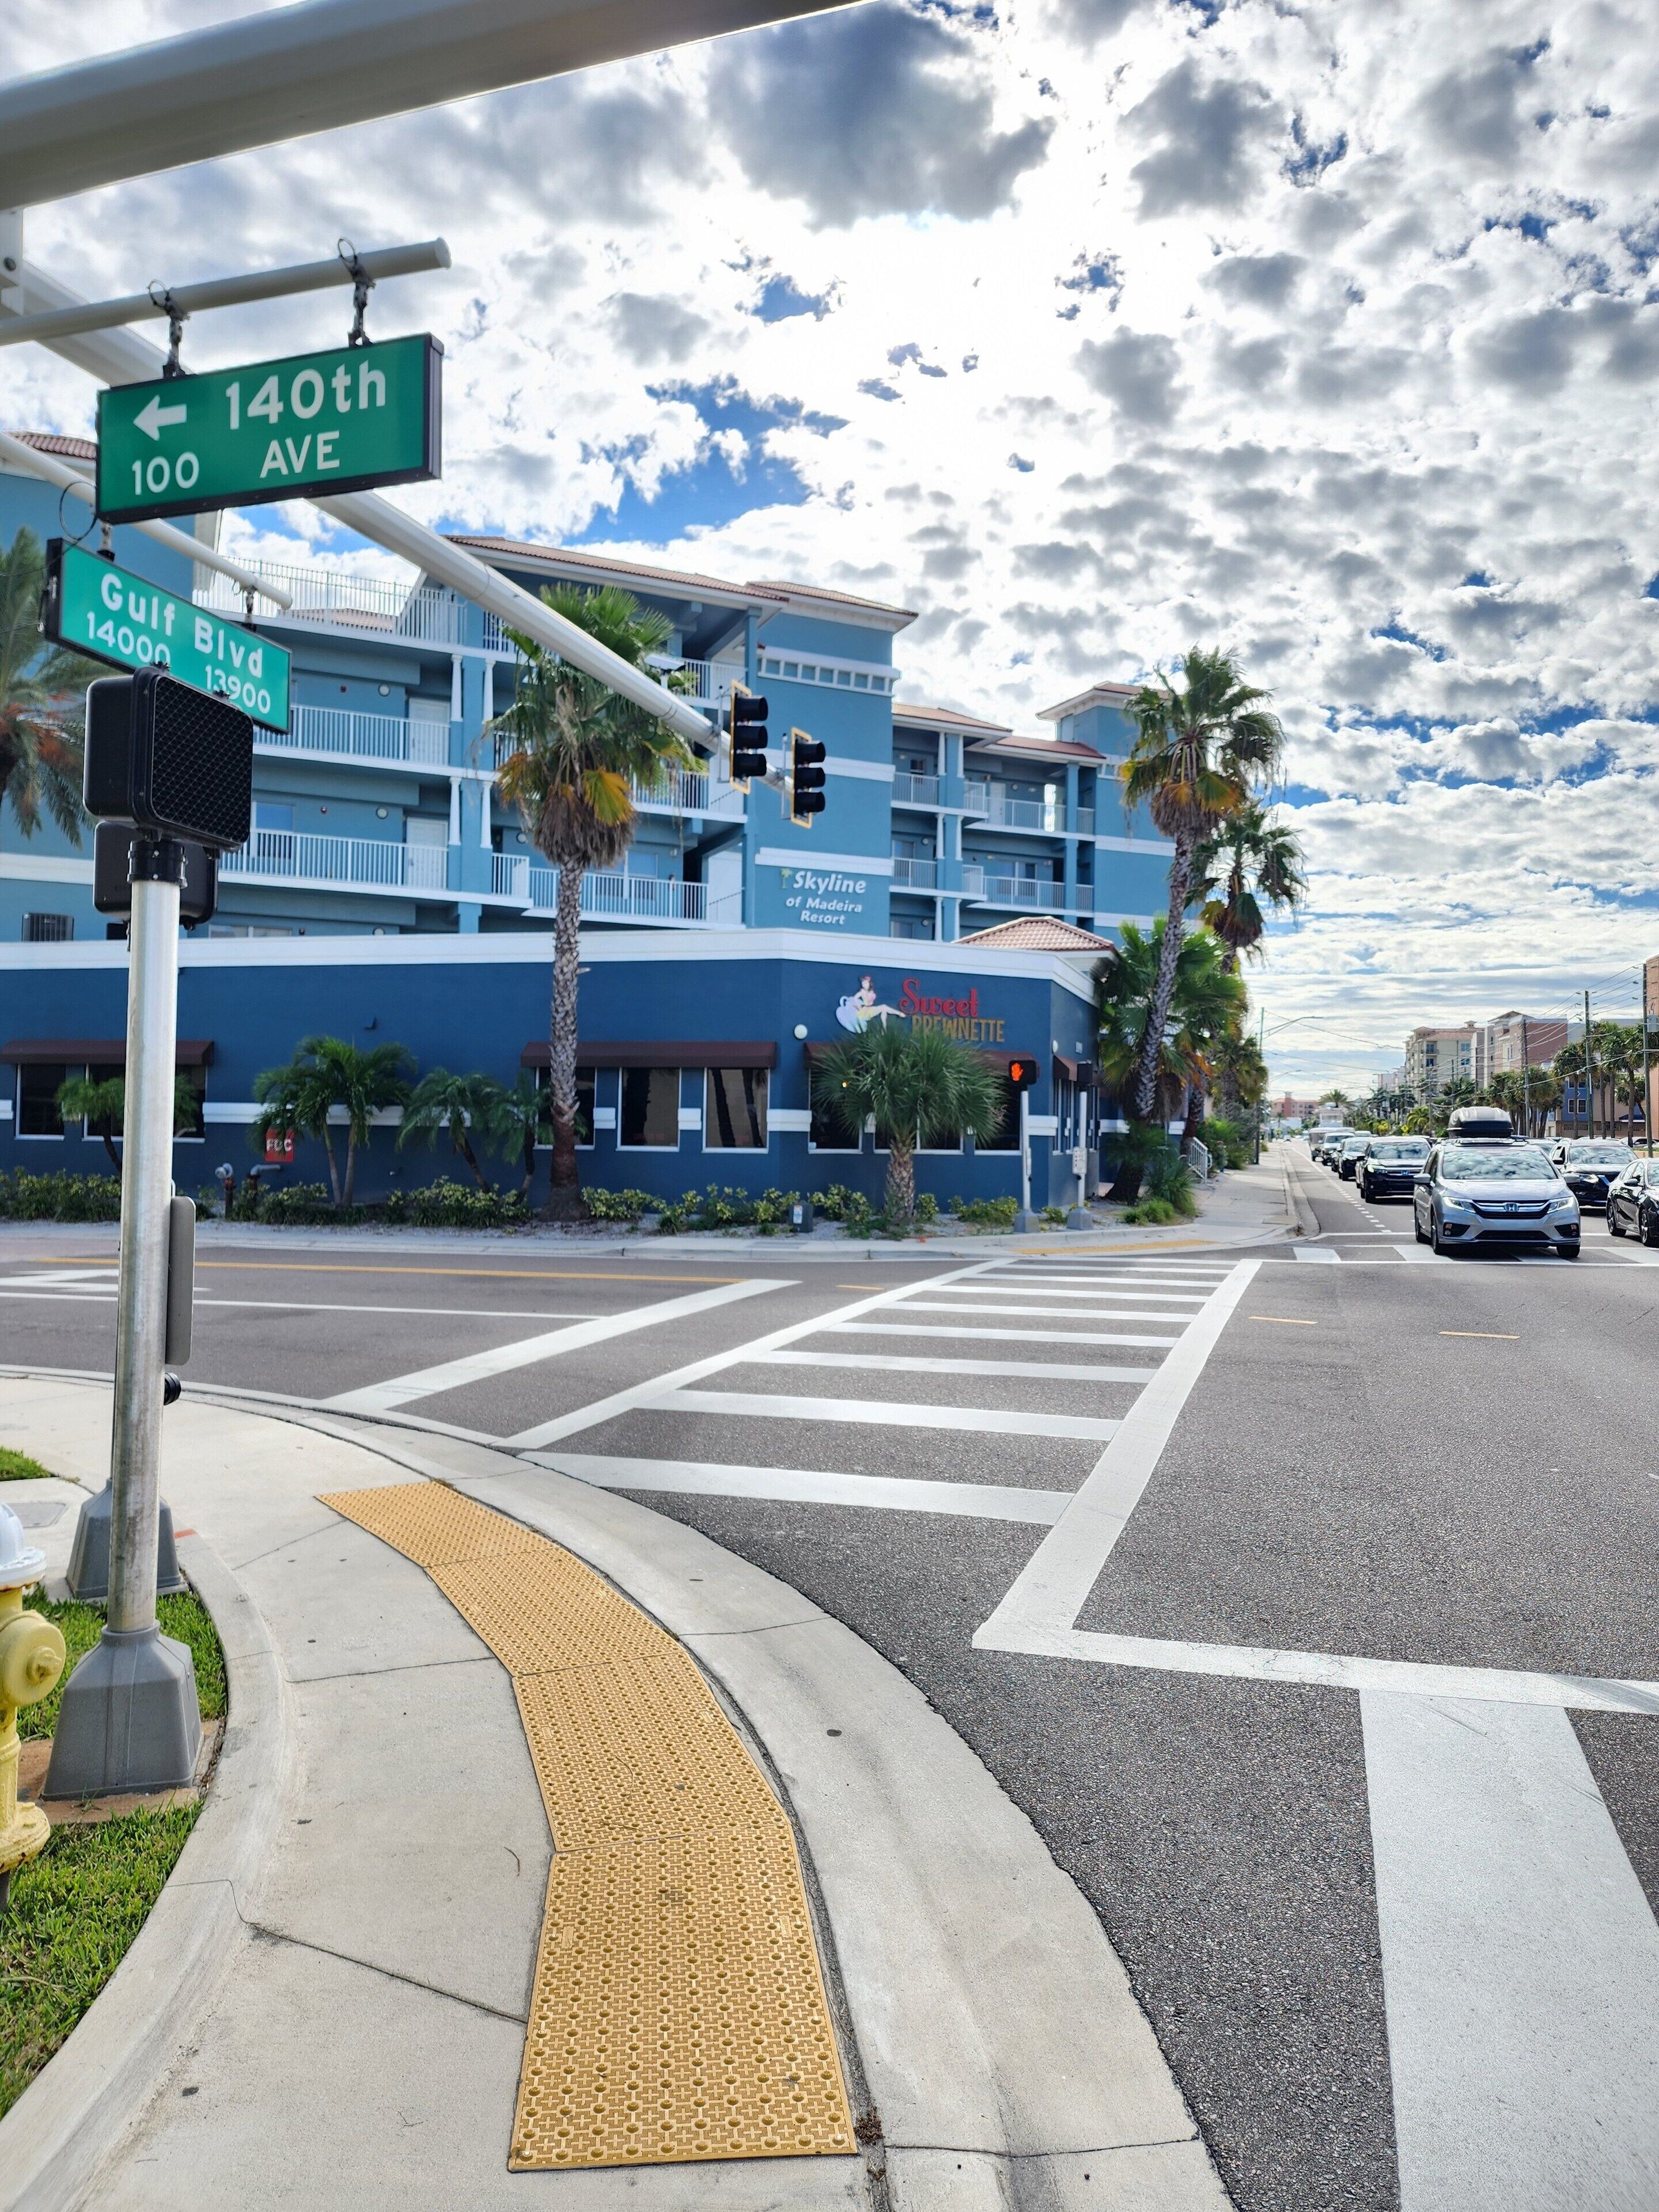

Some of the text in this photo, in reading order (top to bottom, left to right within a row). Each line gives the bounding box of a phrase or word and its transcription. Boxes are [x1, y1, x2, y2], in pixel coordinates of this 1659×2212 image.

[226, 361, 386, 430] 140th
[132, 452, 200, 495] 100
[260, 430, 340, 478] AVE
[101, 573, 263, 679] Gulf Blvd
[87, 611, 271, 714] 14000 13900
[786, 895, 862, 912] of Madeira
[793, 870, 866, 895] Skyline
[801, 910, 845, 925] Resort
[900, 978, 978, 1018] Sweet
